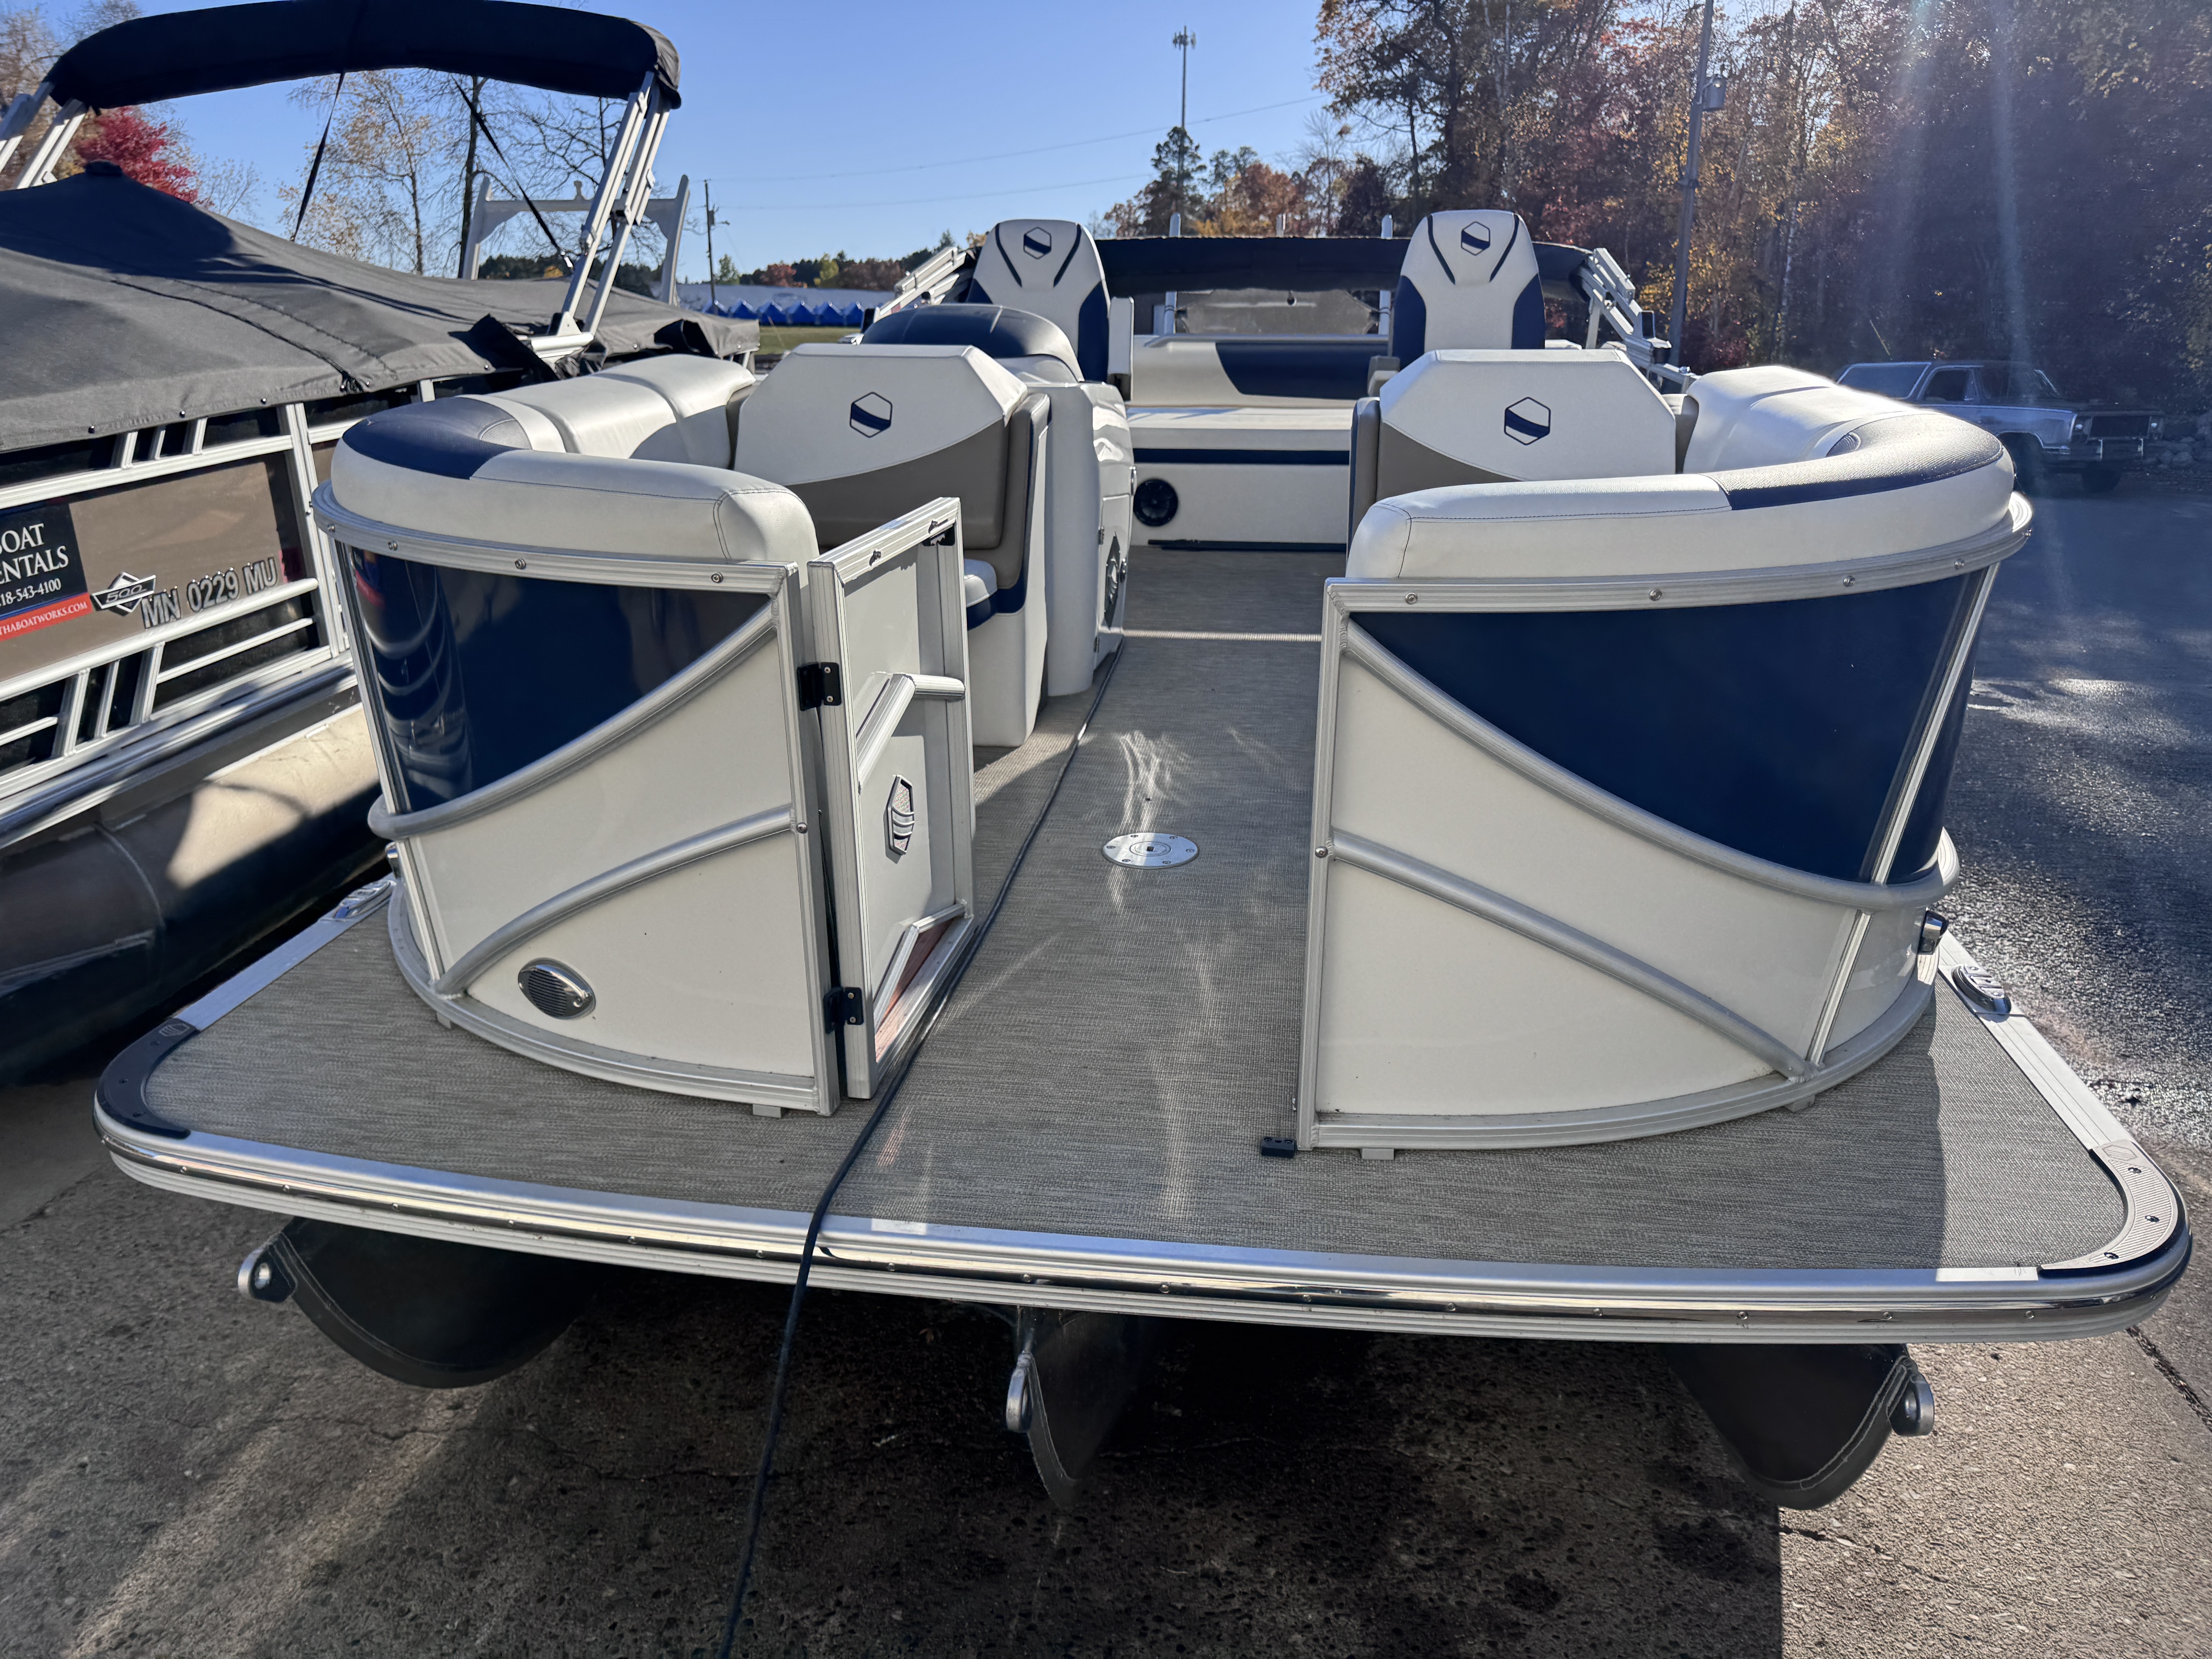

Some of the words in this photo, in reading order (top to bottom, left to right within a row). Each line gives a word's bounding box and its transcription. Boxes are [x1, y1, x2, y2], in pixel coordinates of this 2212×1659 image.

[0, 523, 45, 554] OAT
[0, 546, 69, 584] NTALS
[0, 578, 61, 606] 18-543-4100
[106, 584, 143, 603] 500
[141, 587, 181, 629] MN
[187, 568, 239, 612] 0229
[242, 557, 278, 596] MU
